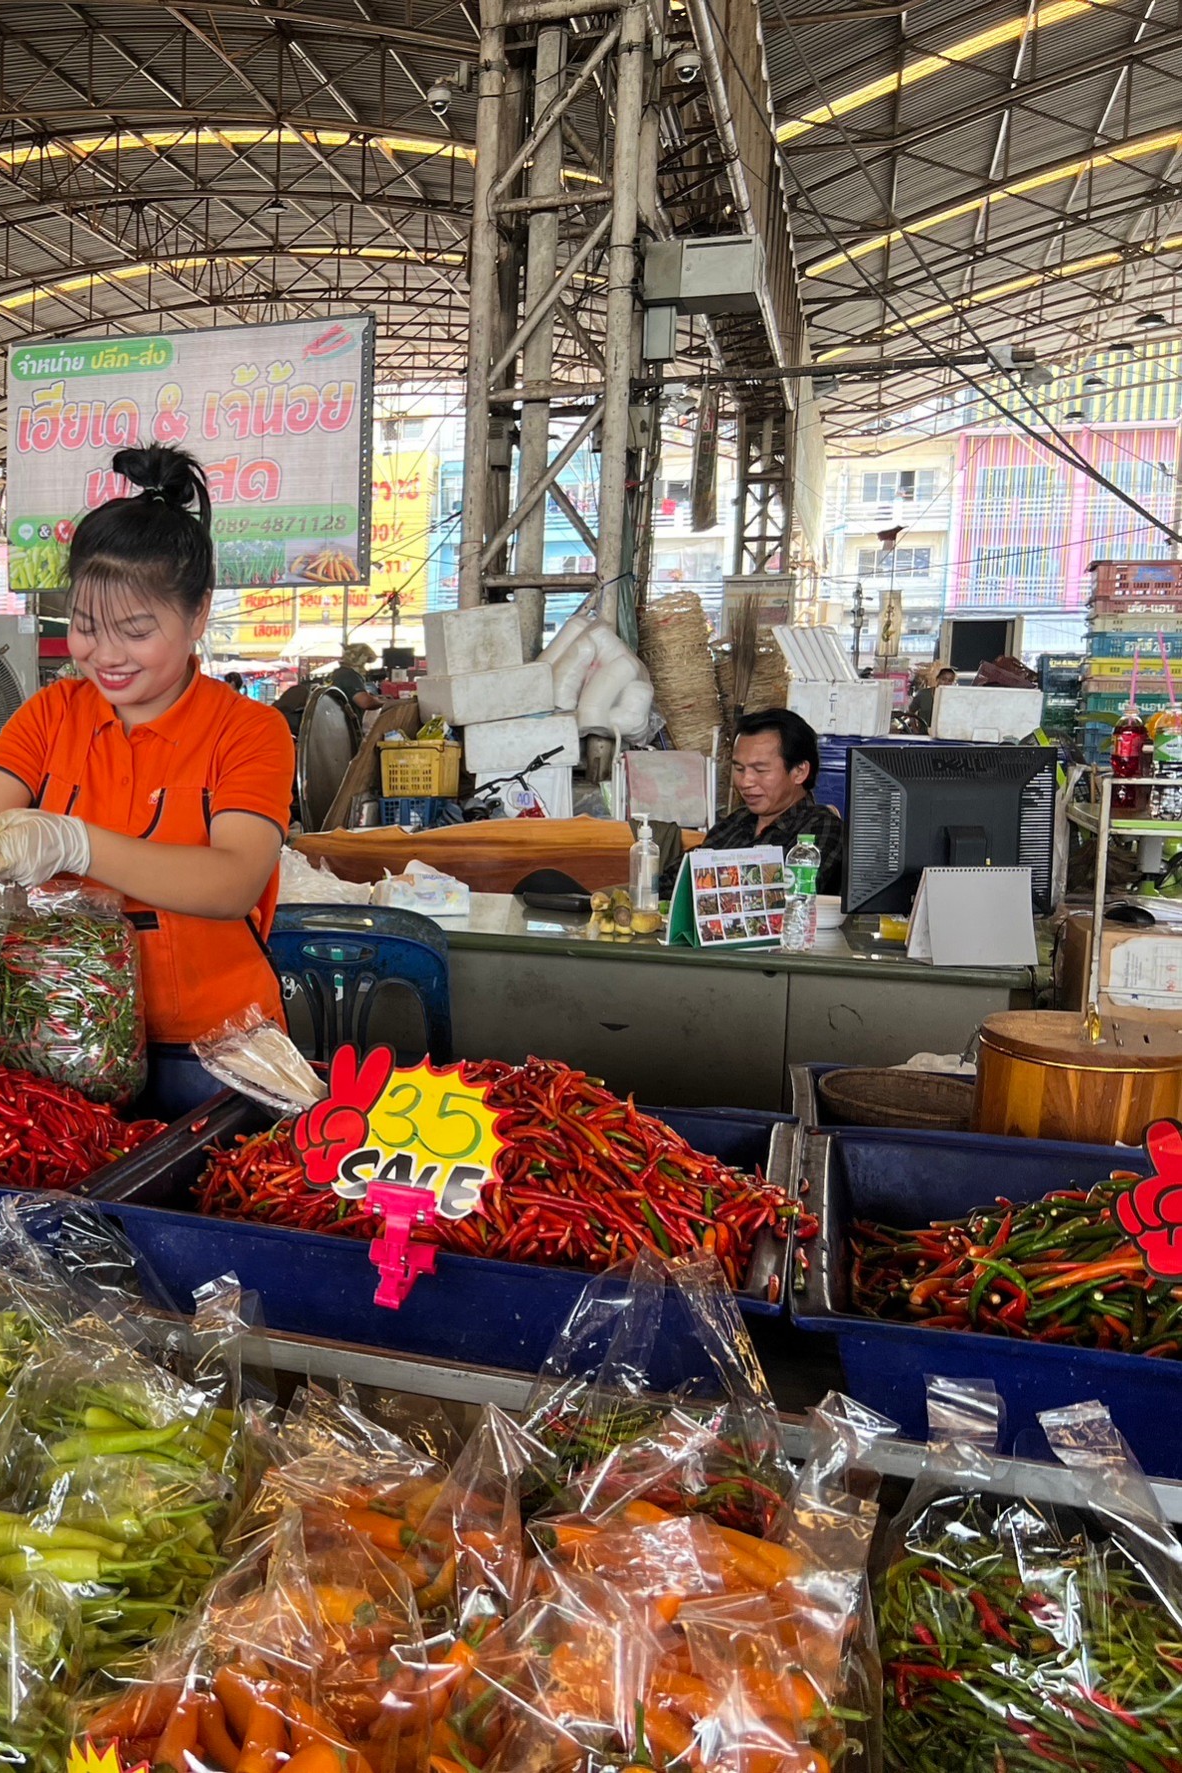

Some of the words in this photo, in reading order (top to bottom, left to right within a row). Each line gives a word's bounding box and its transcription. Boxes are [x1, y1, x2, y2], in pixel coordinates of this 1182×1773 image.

[18, 351, 84, 375] จำหน่าย
[91, 343, 166, 370] ปลีก-ส่ง
[151, 382, 190, 443] &
[214, 515, 347, 534] 089-4871128
[932, 758, 987, 772] DELL
[370, 1082, 489, 1160] 35
